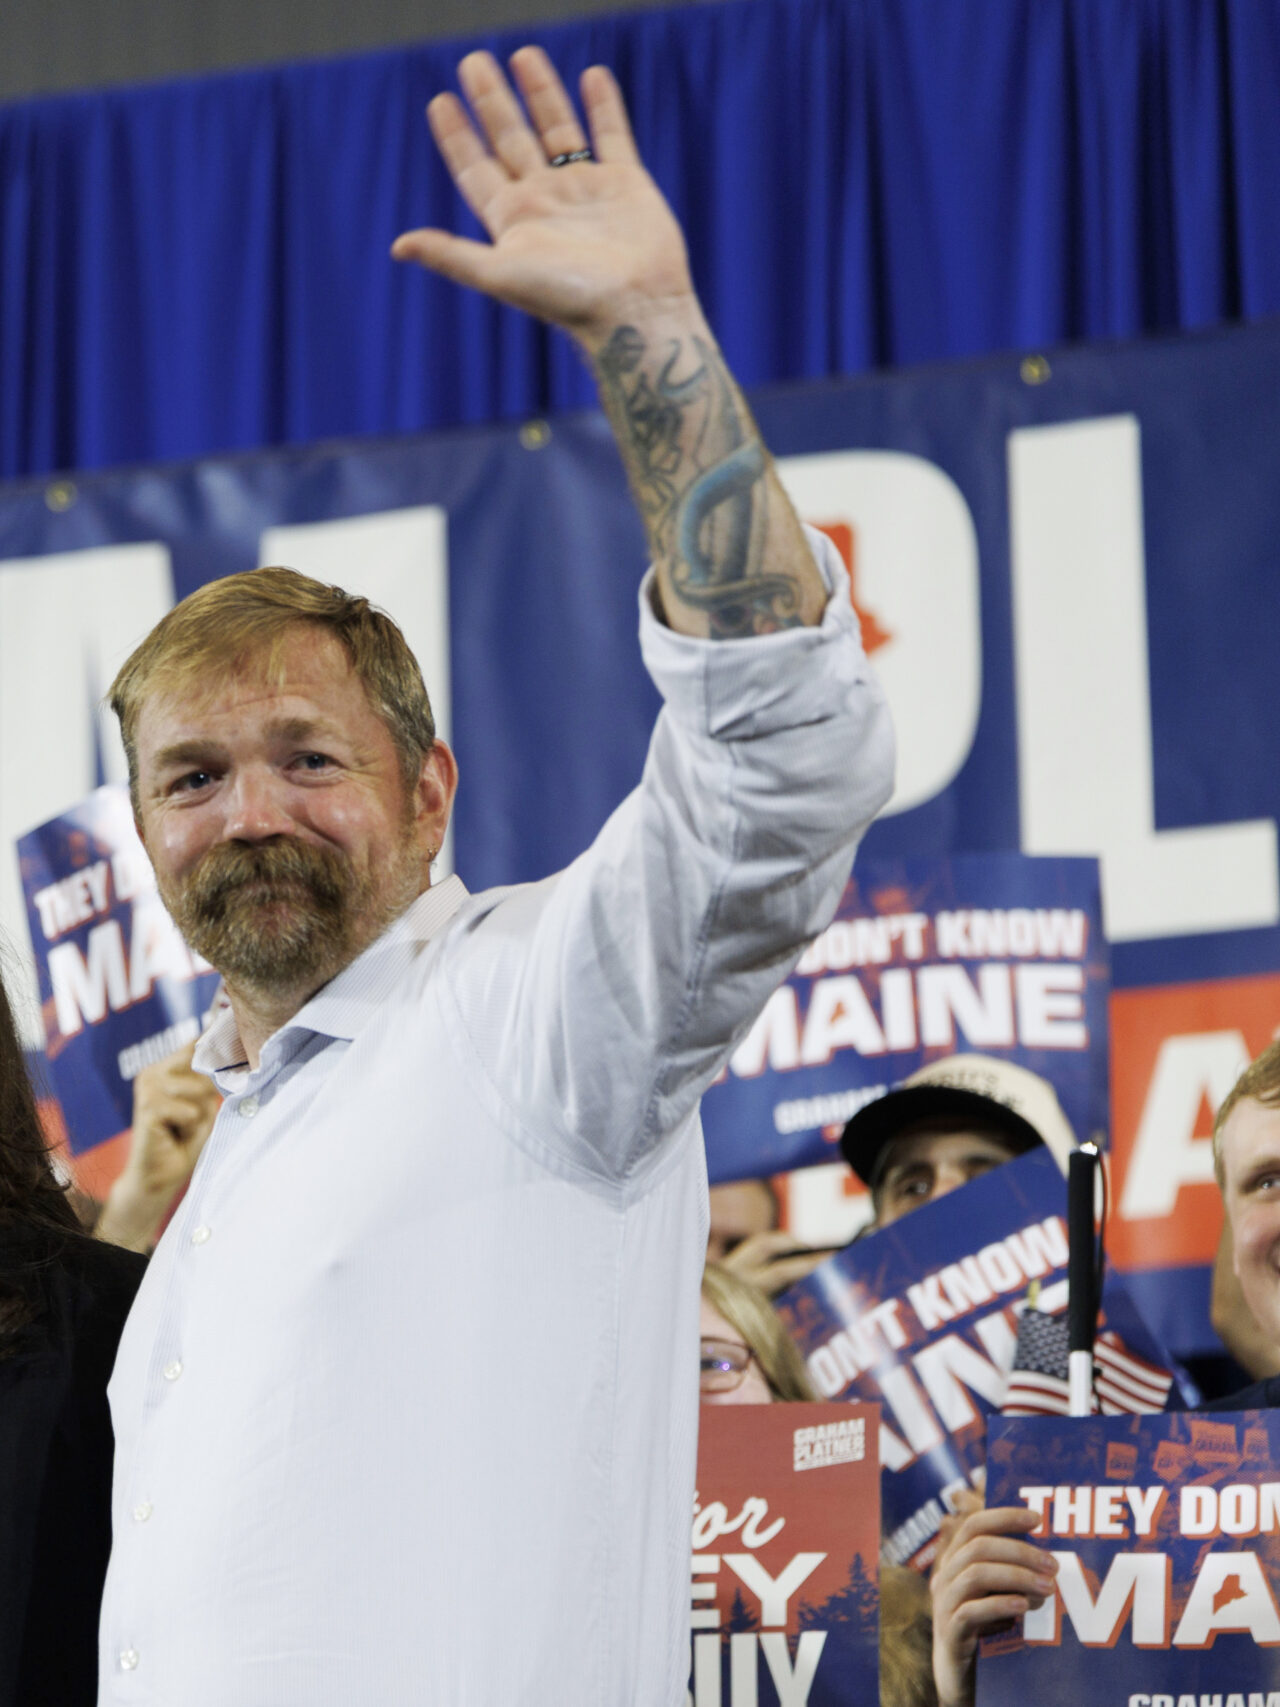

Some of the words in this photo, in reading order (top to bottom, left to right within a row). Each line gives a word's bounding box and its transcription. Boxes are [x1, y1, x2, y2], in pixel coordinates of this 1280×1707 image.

[935, 909, 1086, 957] KNOW
[906, 1215, 1071, 1331] KNOW
[1019, 1485, 1165, 1536] THEY
